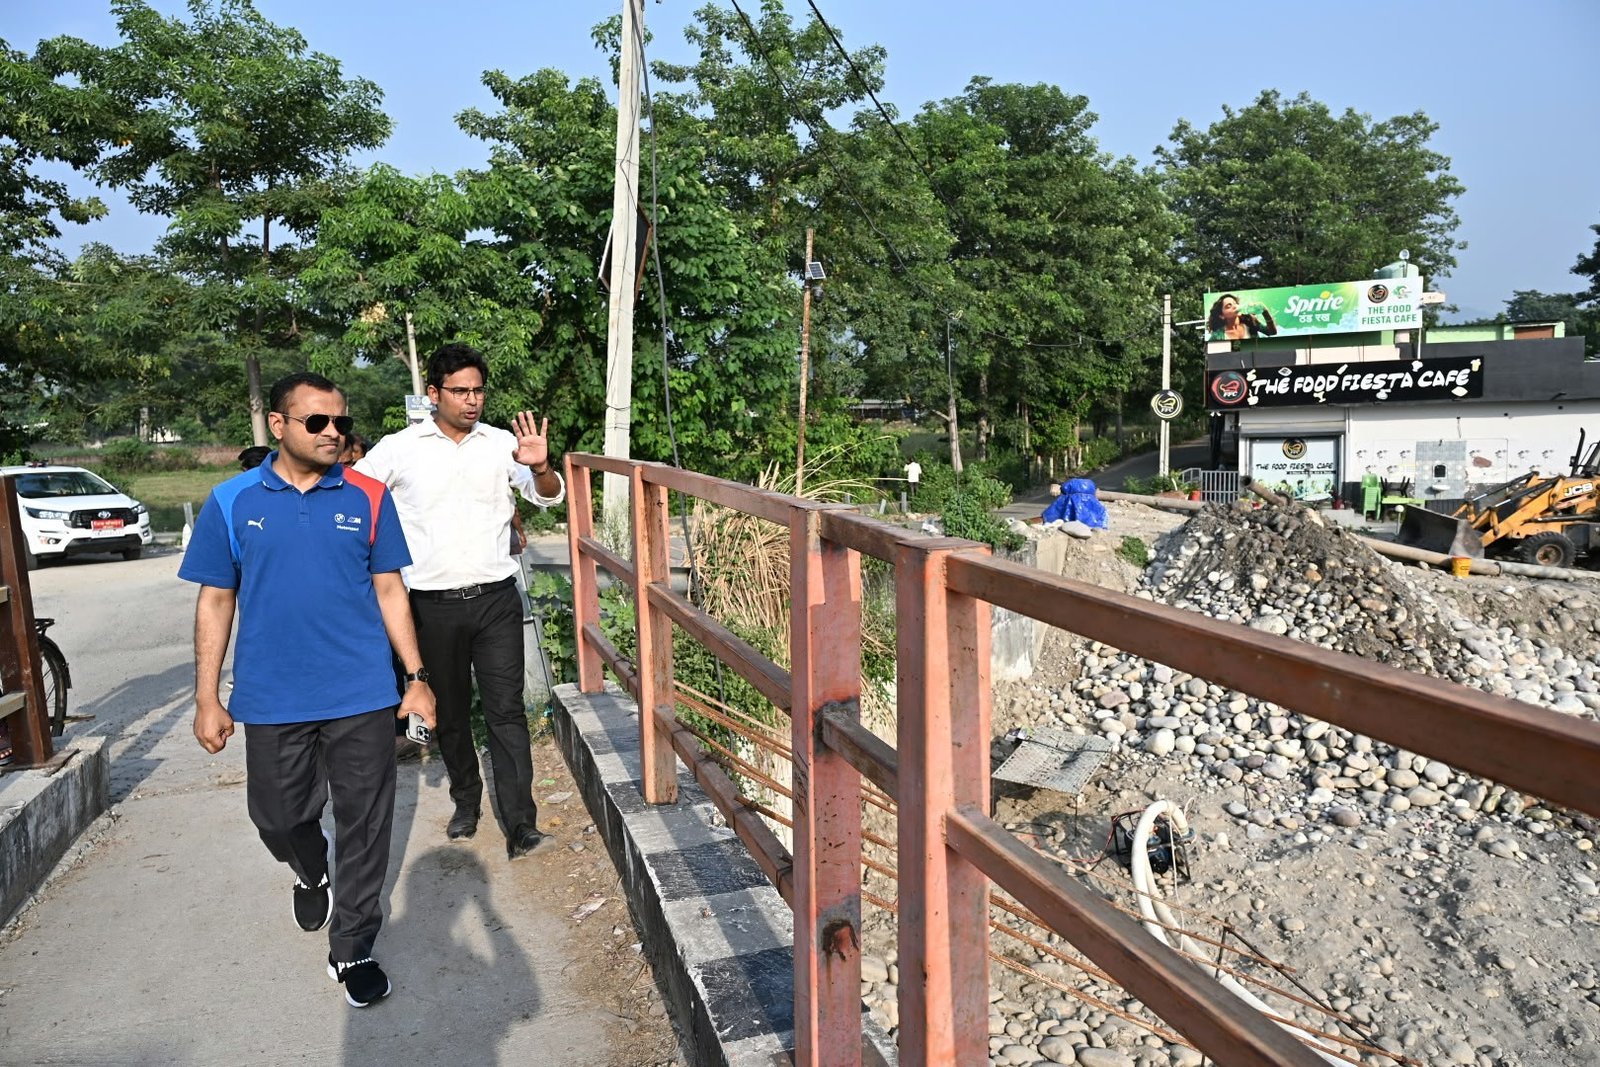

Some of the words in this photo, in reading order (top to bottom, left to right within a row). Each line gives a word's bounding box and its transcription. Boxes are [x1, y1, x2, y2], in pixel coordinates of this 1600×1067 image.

[1284, 291, 1344, 316] Sprite
[1368, 305, 1384, 315] THE
[1387, 304, 1412, 314] FOOD
[1361, 315, 1391, 325] FIESTA
[1394, 313, 1417, 323] CAFE
[1251, 377, 1290, 395] THE
[1293, 375, 1339, 393] FOOD
[1341, 372, 1413, 391] FIESTA
[1417, 368, 1471, 387] CAFE
[1564, 482, 1593, 497] JCB
